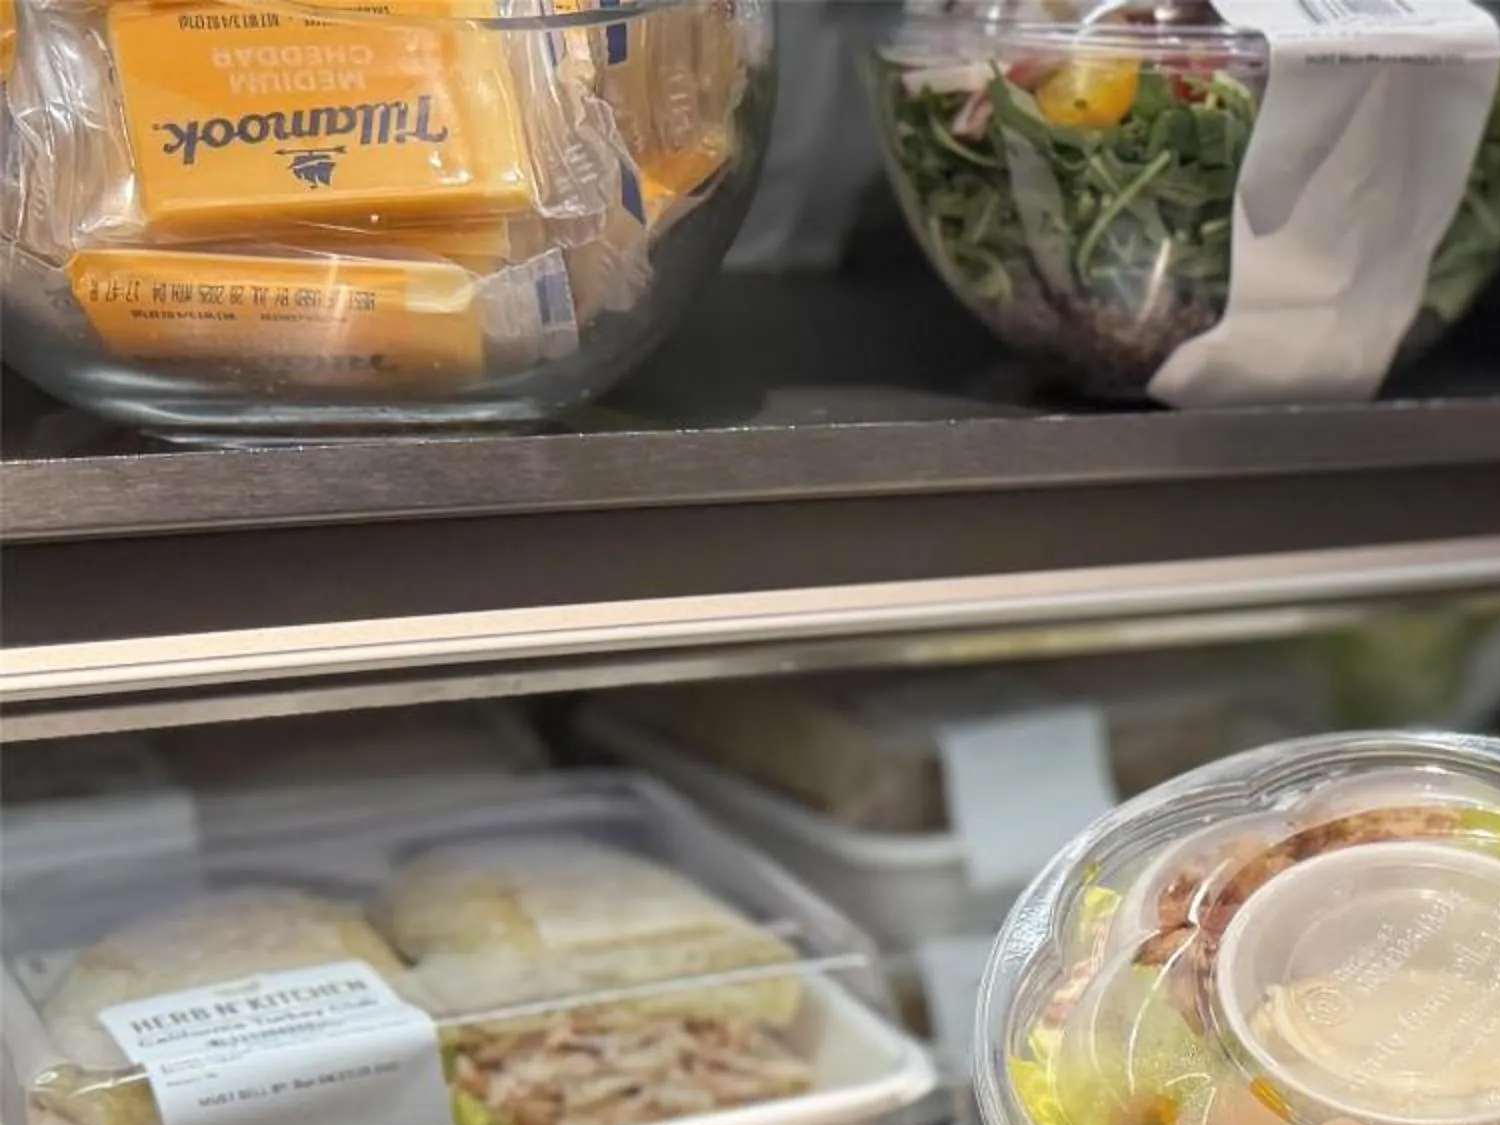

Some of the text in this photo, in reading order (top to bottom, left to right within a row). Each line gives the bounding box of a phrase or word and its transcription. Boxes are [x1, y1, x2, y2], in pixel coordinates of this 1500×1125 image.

[211, 44, 374, 68] CHEDDAR
[229, 68, 367, 95] MEDIUM
[160, 95, 449, 165] Tillamook
[130, 1007, 211, 1035] HERB
